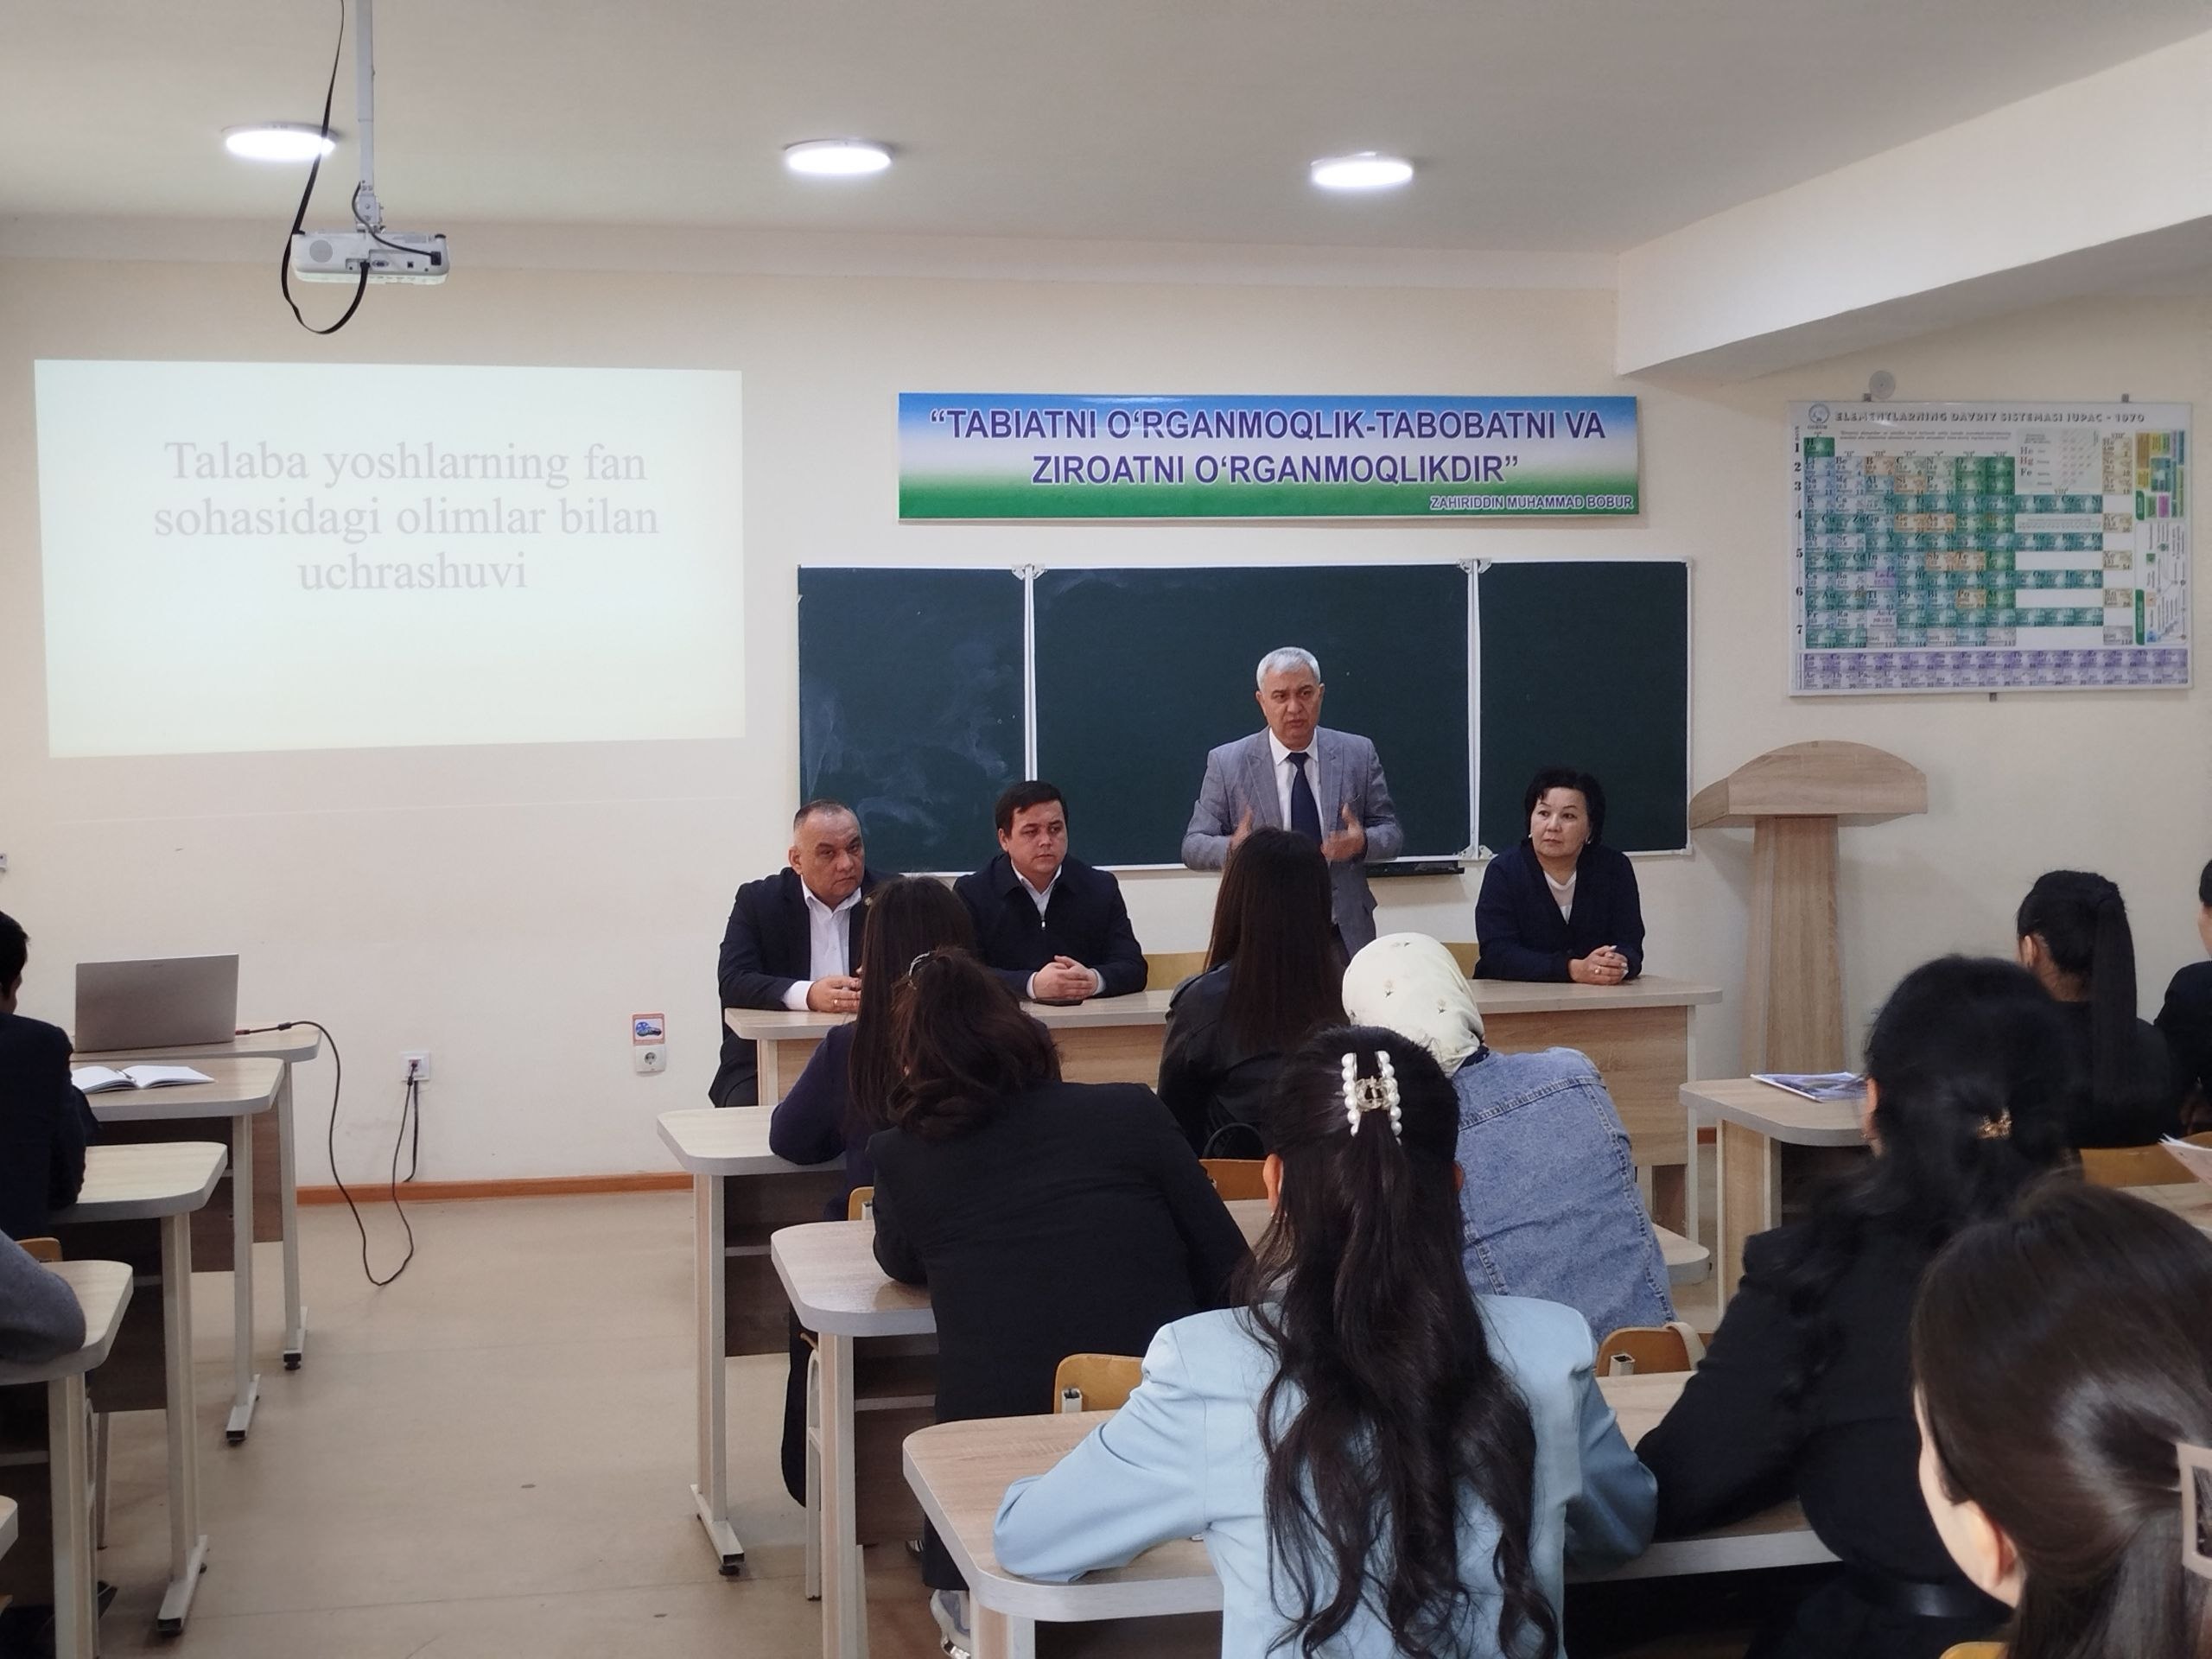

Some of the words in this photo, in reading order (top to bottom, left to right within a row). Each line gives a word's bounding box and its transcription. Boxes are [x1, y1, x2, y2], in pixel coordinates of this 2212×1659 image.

[1835, 411, 1948, 422] ELEMENTLARNING
[1951, 412, 1997, 422] DAVRIY
[2000, 412, 2063, 423] SISTEMASI
[2067, 412, 2103, 423] IUPAC
[2116, 413, 2145, 423] 1970
[931, 410, 1096, 439] “TABIATNI
[1566, 411, 1606, 439] VA
[1795, 442, 1800, 453] 1
[164, 441, 310, 480] Talaba
[323, 441, 570, 490] yoshlarning
[583, 442, 649, 481] fan
[1794, 461, 1802, 472] 2
[2019, 456, 2034, 467] Hg
[1032, 455, 1185, 484] ZIROATNI
[2020, 467, 2032, 477] Fe
[1794, 480, 1802, 491] 3
[1429, 495, 1503, 510] ZAHIRIDDIN
[1506, 495, 1584, 509] MUHAMMAD
[1586, 496, 1634, 509] BOBUR
[1795, 509, 1802, 519] 4
[154, 496, 383, 544] sohasidagi
[396, 497, 546, 536] olimlar
[559, 497, 661, 536] bilan
[1796, 548, 1803, 558] 5
[298, 550, 529, 591] uchrashuvi
[1796, 587, 1803, 596] 6
[1796, 624, 1803, 634] 7
